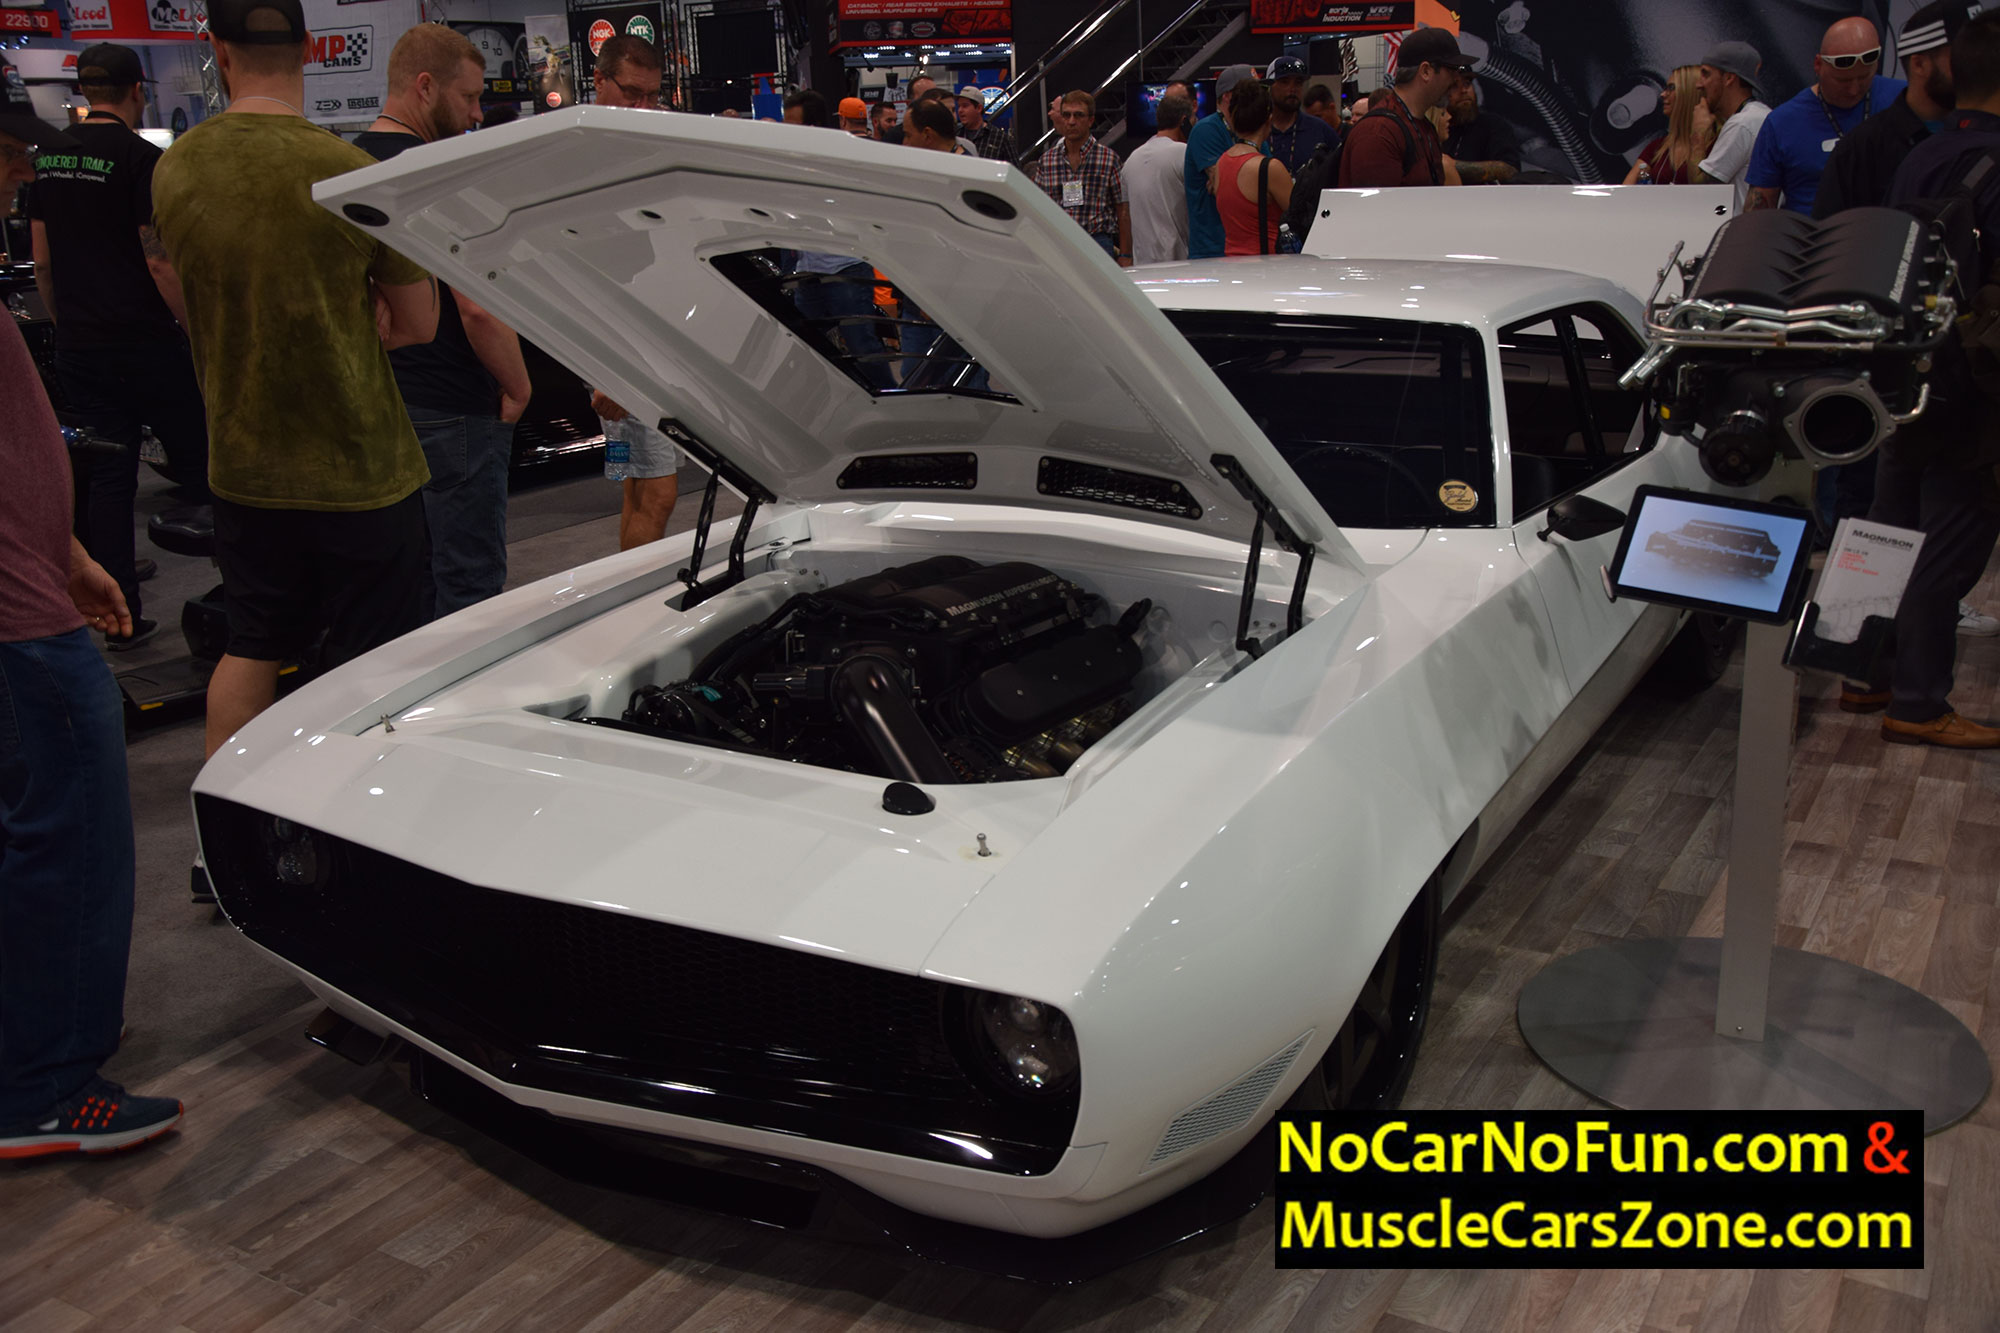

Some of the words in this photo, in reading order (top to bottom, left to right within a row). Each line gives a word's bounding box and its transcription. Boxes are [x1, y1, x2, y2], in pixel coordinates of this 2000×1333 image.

[592, 28, 611, 39] NGK
[630, 25, 649, 35] NTK
[481, 41, 489, 50] 9
[492, 48, 503, 56] 10
[323, 56, 361, 68] CAMS
[82, 156, 114, 174] TRAILZ
[1852, 529, 1914, 549] MAGNUSON
[945, 592, 1006, 617] MAGNUSON
